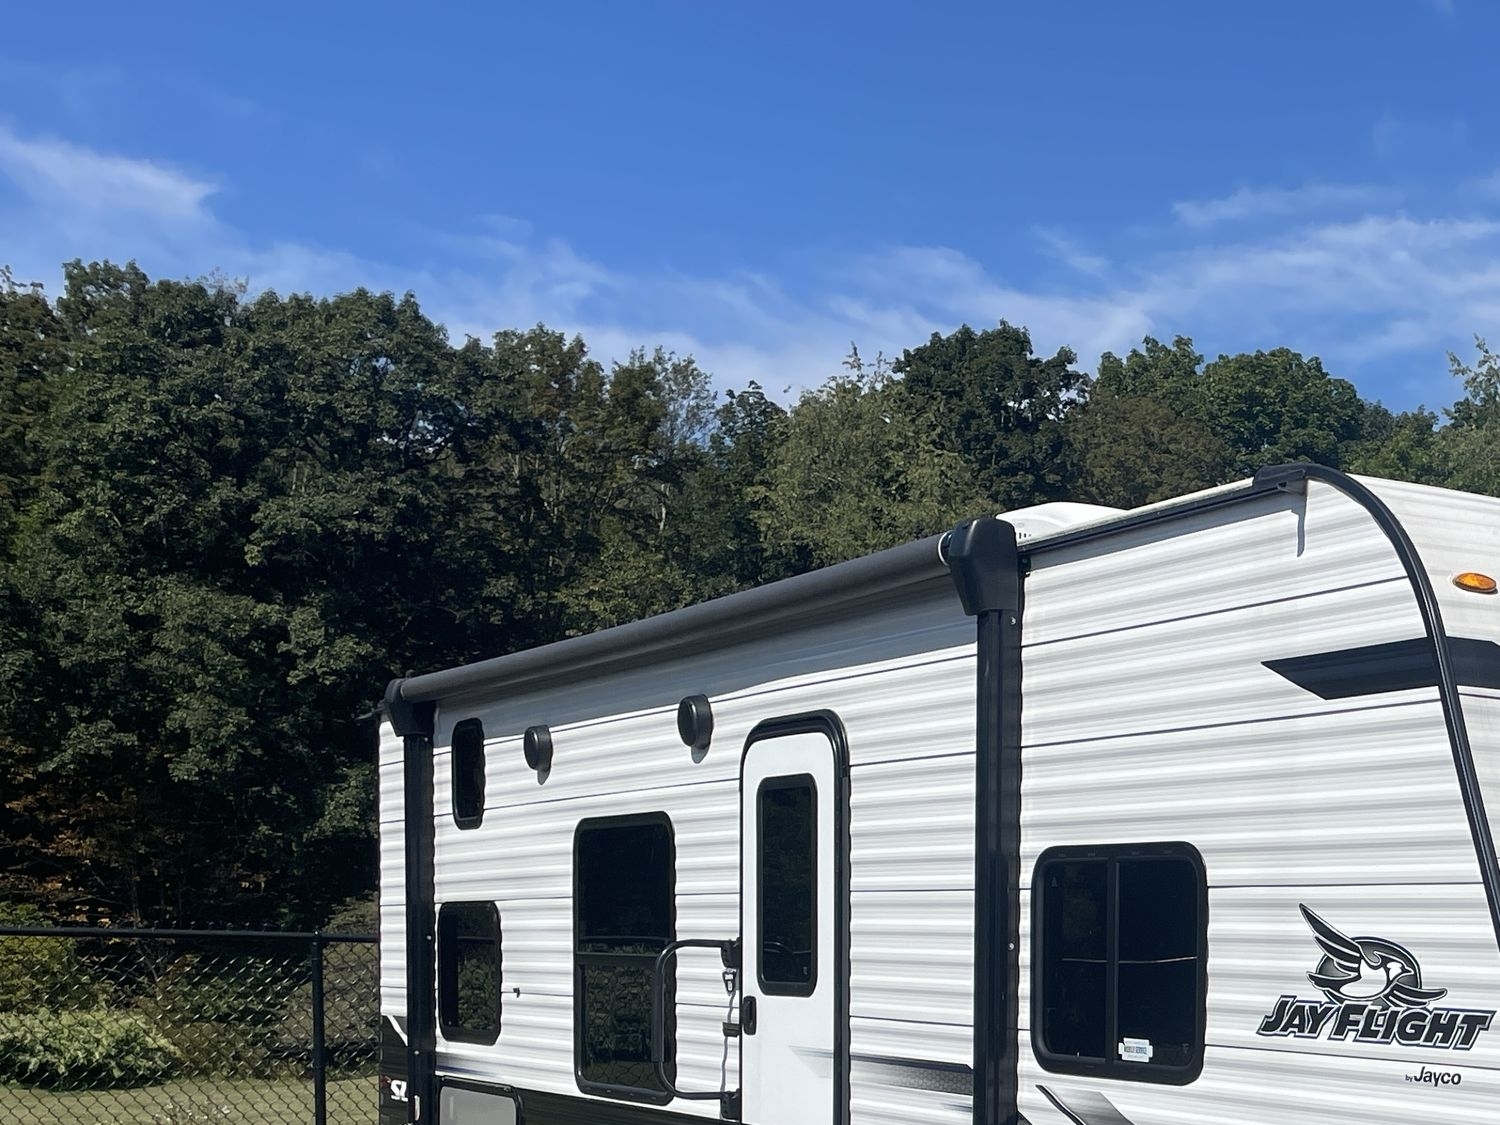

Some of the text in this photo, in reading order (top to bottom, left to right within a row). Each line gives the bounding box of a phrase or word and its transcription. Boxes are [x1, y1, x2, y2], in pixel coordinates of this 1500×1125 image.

[1257, 995, 1497, 1050] JAY FLIGHT
[1413, 1066, 1462, 1087] Jayco
